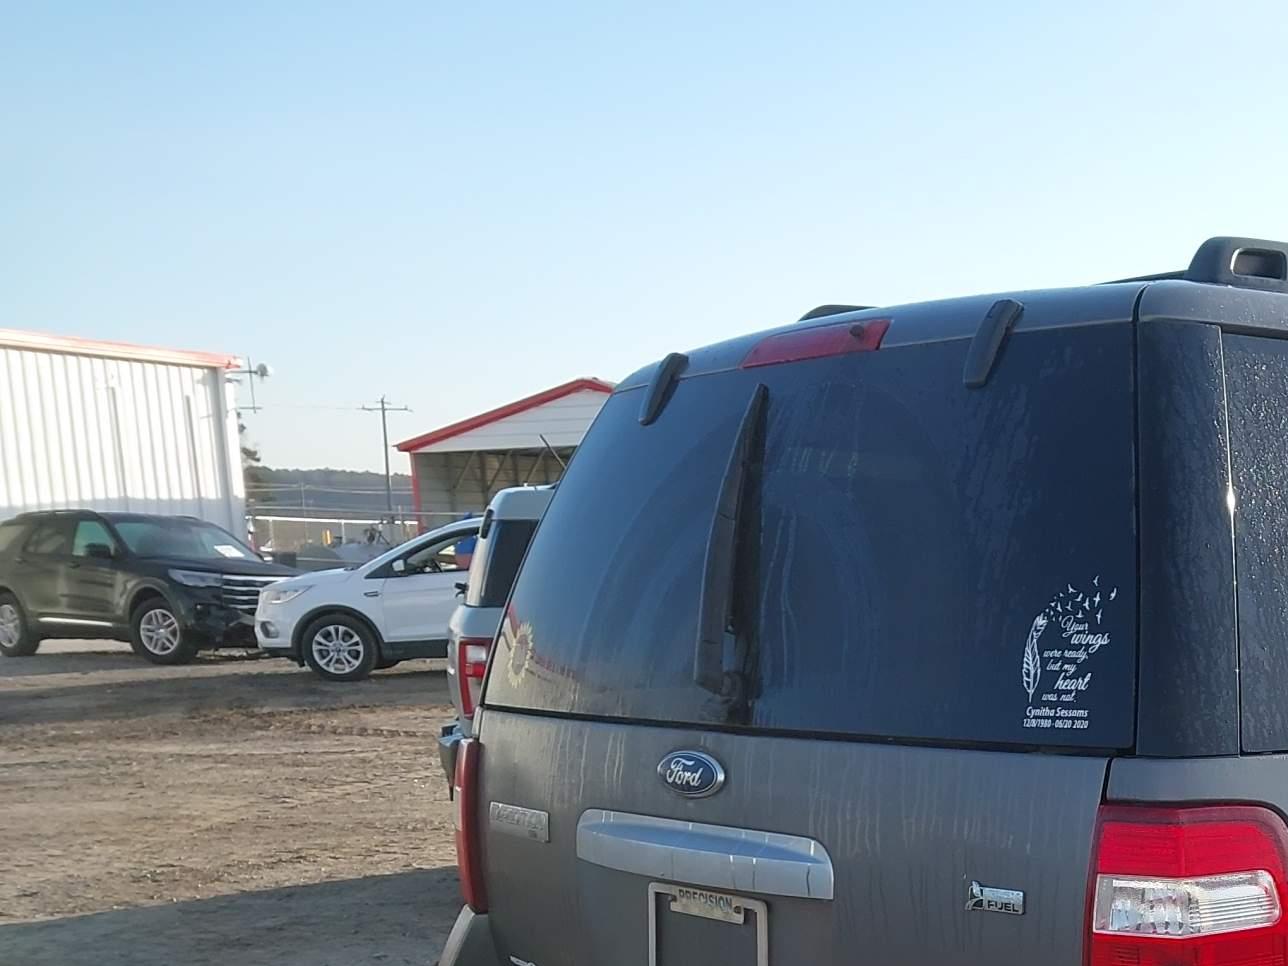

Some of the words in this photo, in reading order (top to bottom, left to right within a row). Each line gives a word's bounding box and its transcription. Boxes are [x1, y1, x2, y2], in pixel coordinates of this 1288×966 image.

[1061, 615, 1088, 637] Your
[1070, 631, 1110, 653] wings
[1043, 649, 1062, 657] were
[1046, 659, 1062, 670] but
[1062, 664, 1077, 676] my
[1054, 672, 1092, 690] heart
[1041, 693, 1057, 701] was
[1026, 706, 1055, 718] Cynitha
[666, 757, 703, 787] Ford
[987, 899, 1019, 912] FUEL
